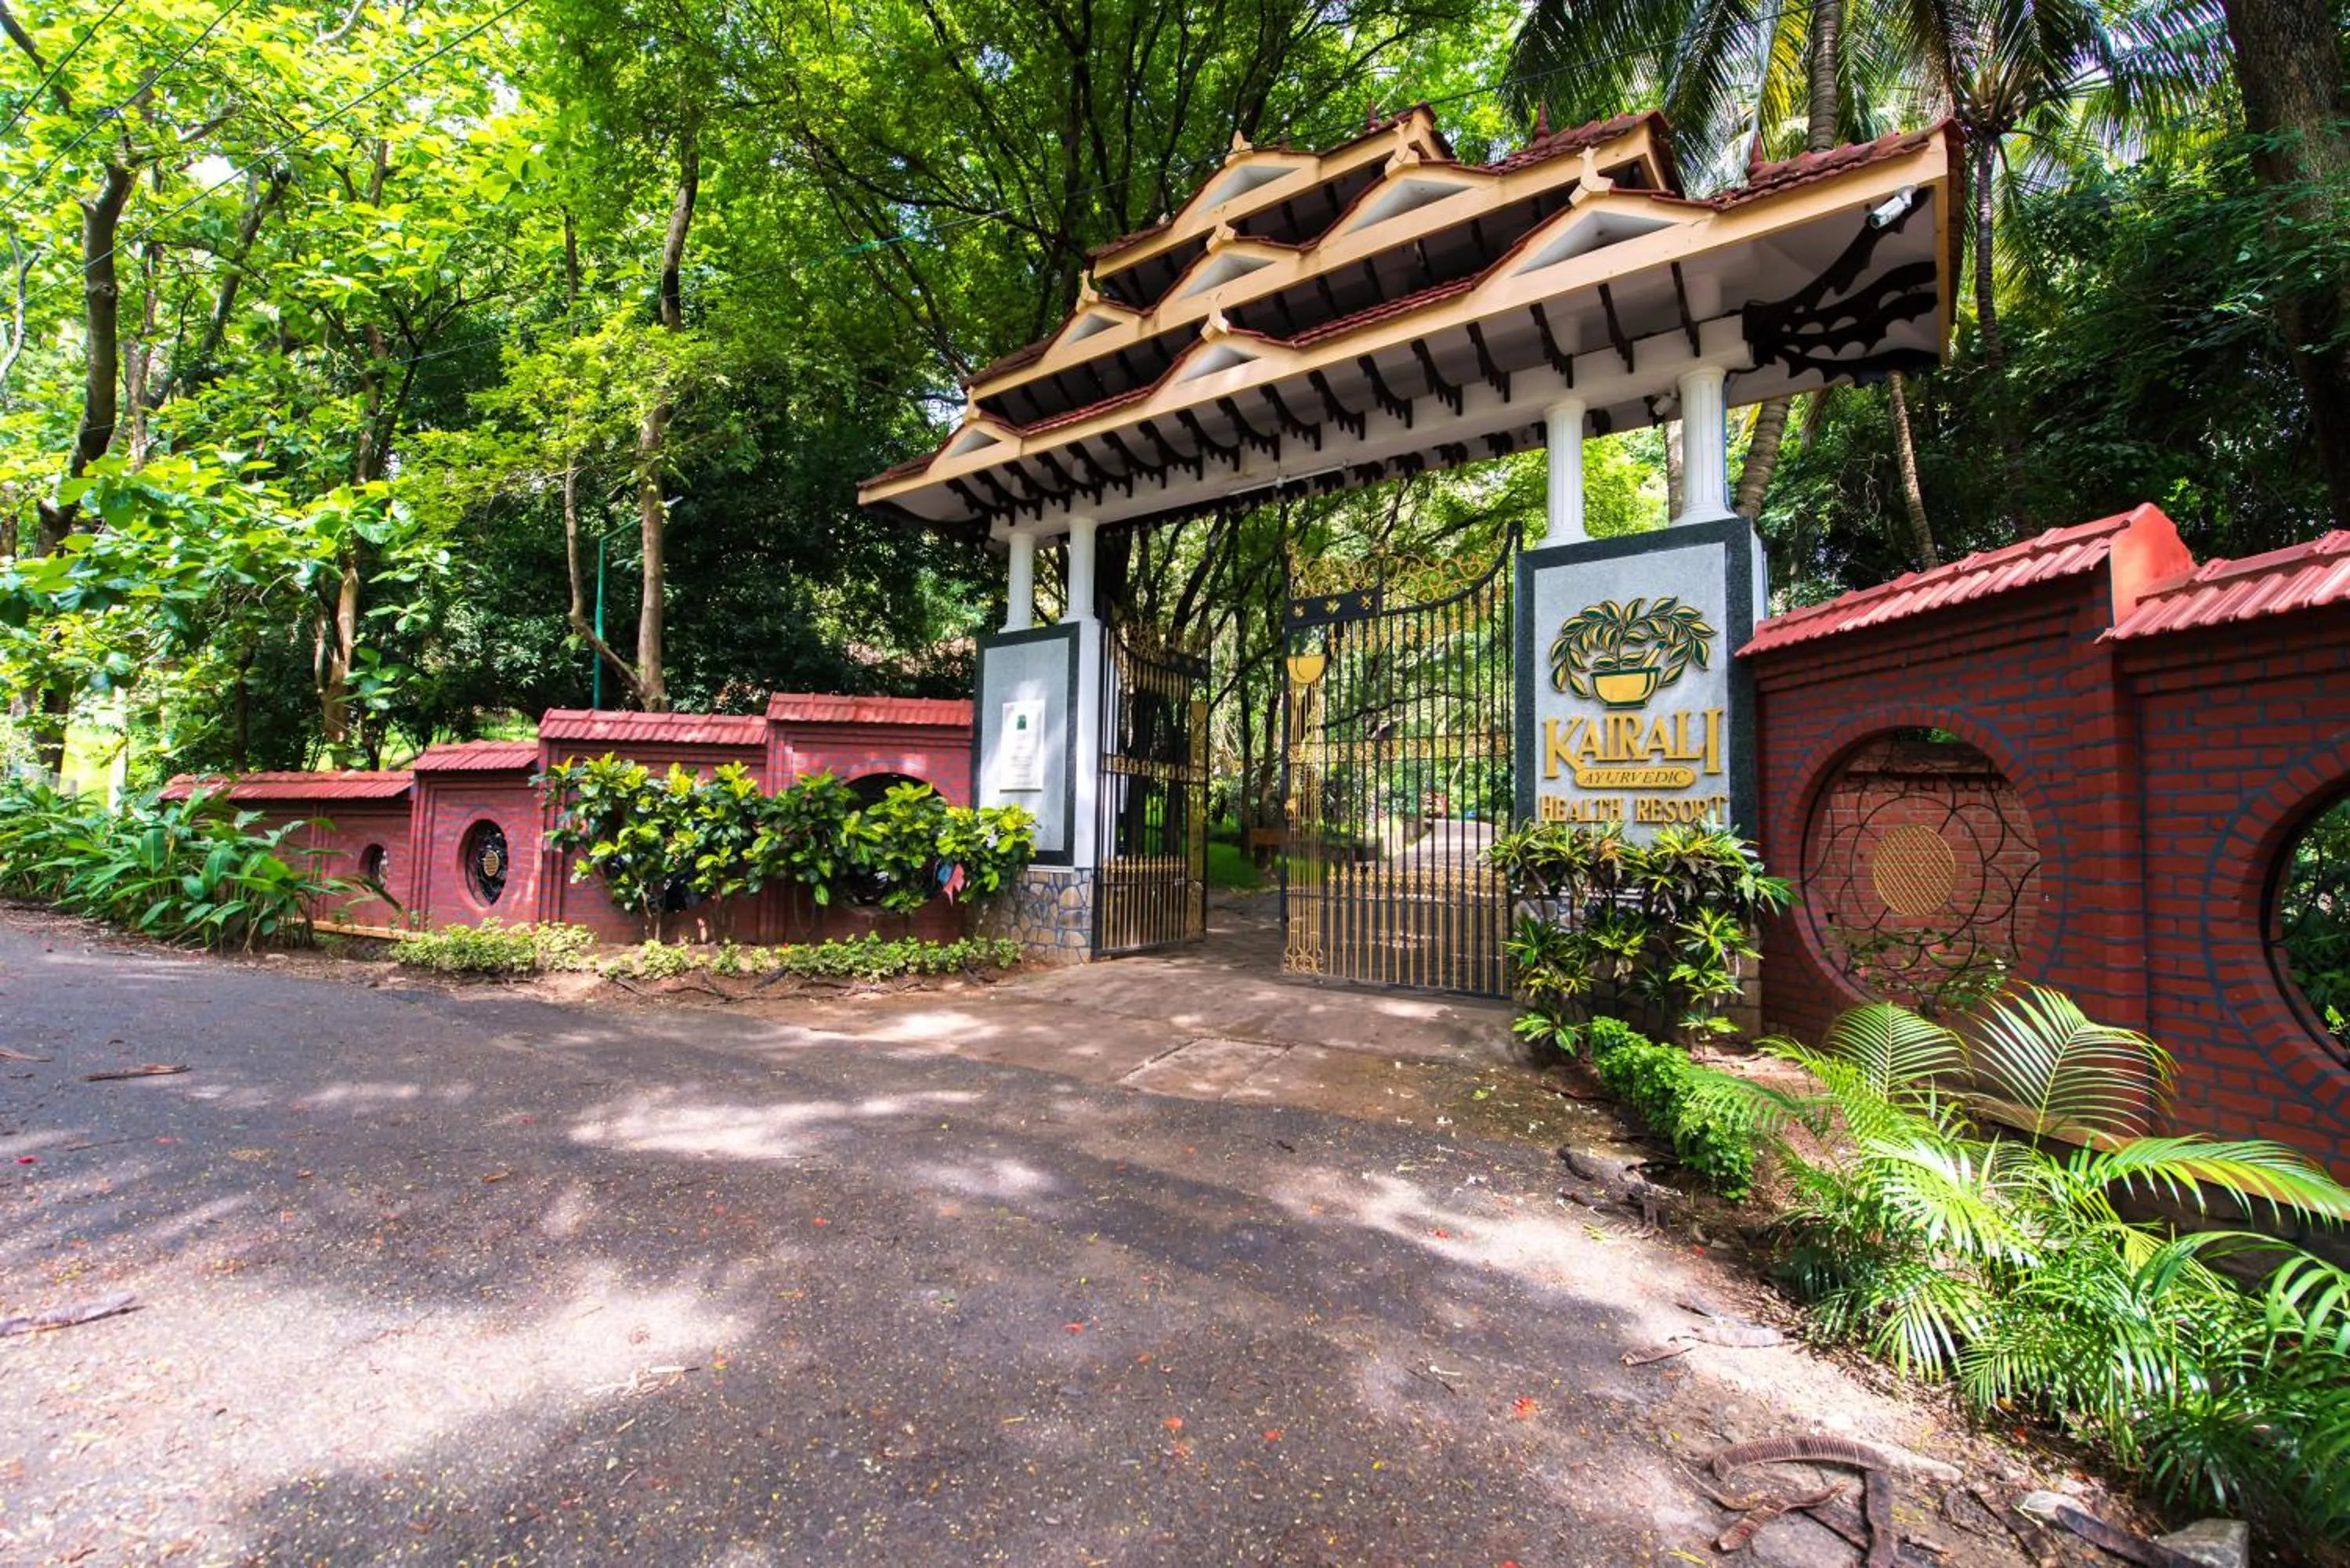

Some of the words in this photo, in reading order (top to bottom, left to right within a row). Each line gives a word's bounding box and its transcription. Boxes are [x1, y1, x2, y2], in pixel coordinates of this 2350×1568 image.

[1543, 708, 1723, 779] KAIRALI
[1583, 770, 1689, 784] AYURVEDIC
[1540, 795, 1624, 822] HEALTH
[1635, 795, 1728, 823] RESORT
